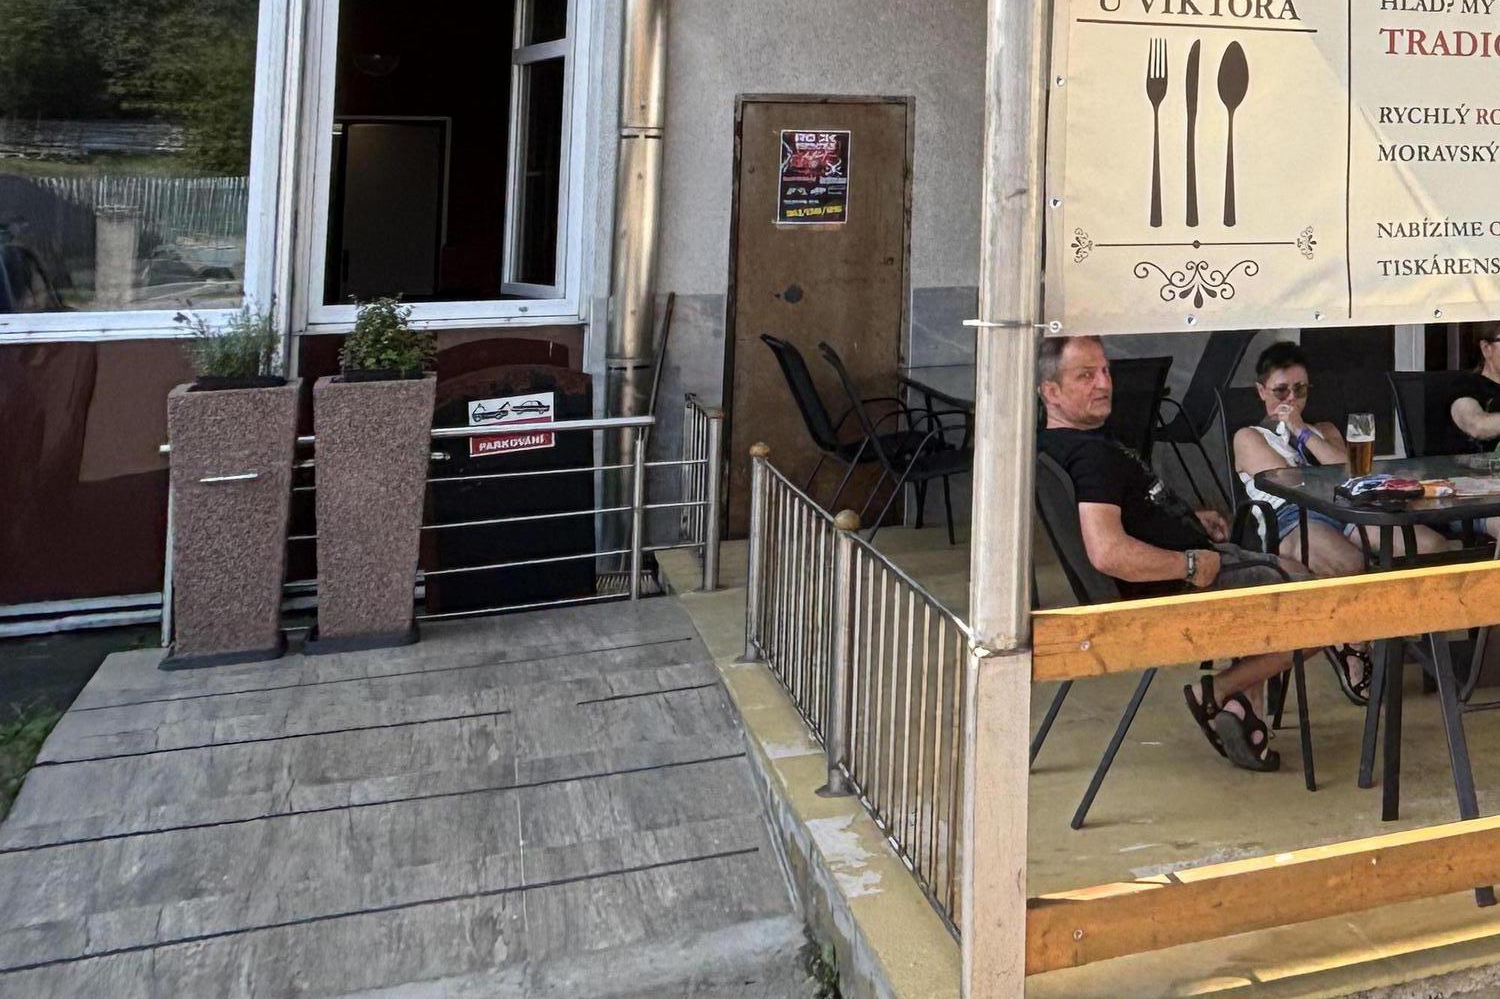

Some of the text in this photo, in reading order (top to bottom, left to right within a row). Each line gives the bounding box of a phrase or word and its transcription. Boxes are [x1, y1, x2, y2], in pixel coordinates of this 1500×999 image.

[1377, 103, 1471, 126] RYCHLÝ
[1377, 140, 1500, 163] MORAVSKÝ
[1376, 216, 1485, 238] NABÍZÍME
